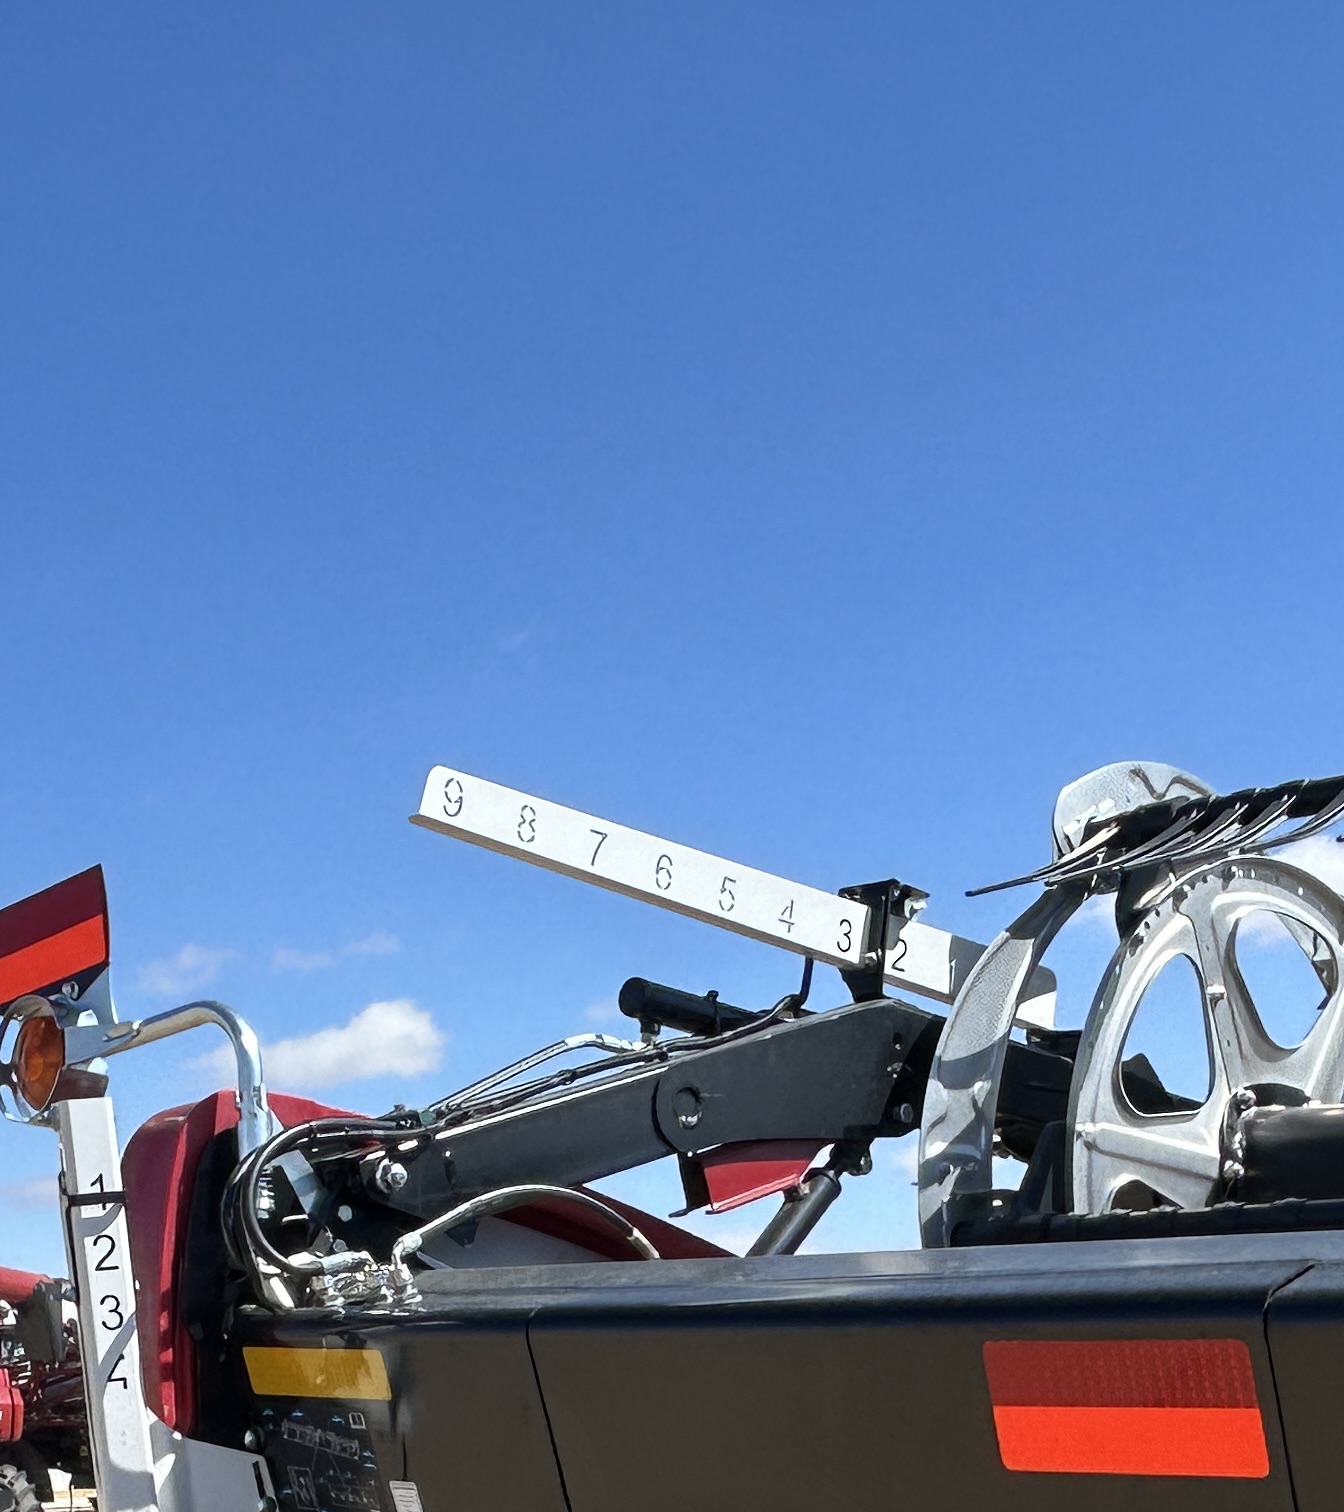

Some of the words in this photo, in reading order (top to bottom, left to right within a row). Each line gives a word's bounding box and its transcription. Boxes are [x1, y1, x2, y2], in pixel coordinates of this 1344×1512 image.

[443, 778, 463, 817] 9
[517, 805, 536, 843] 8
[590, 829, 608, 867] 7
[656, 854, 673, 891] 6
[718, 876, 736, 912] 5
[778, 899, 795, 934] 4
[836, 918, 853, 953] 3
[891, 938, 907, 973] 2
[90, 1173, 107, 1211] 1
[92, 1234, 120, 1272] 2
[99, 1294, 124, 1331] 3
[106, 1352, 128, 1390] 4
